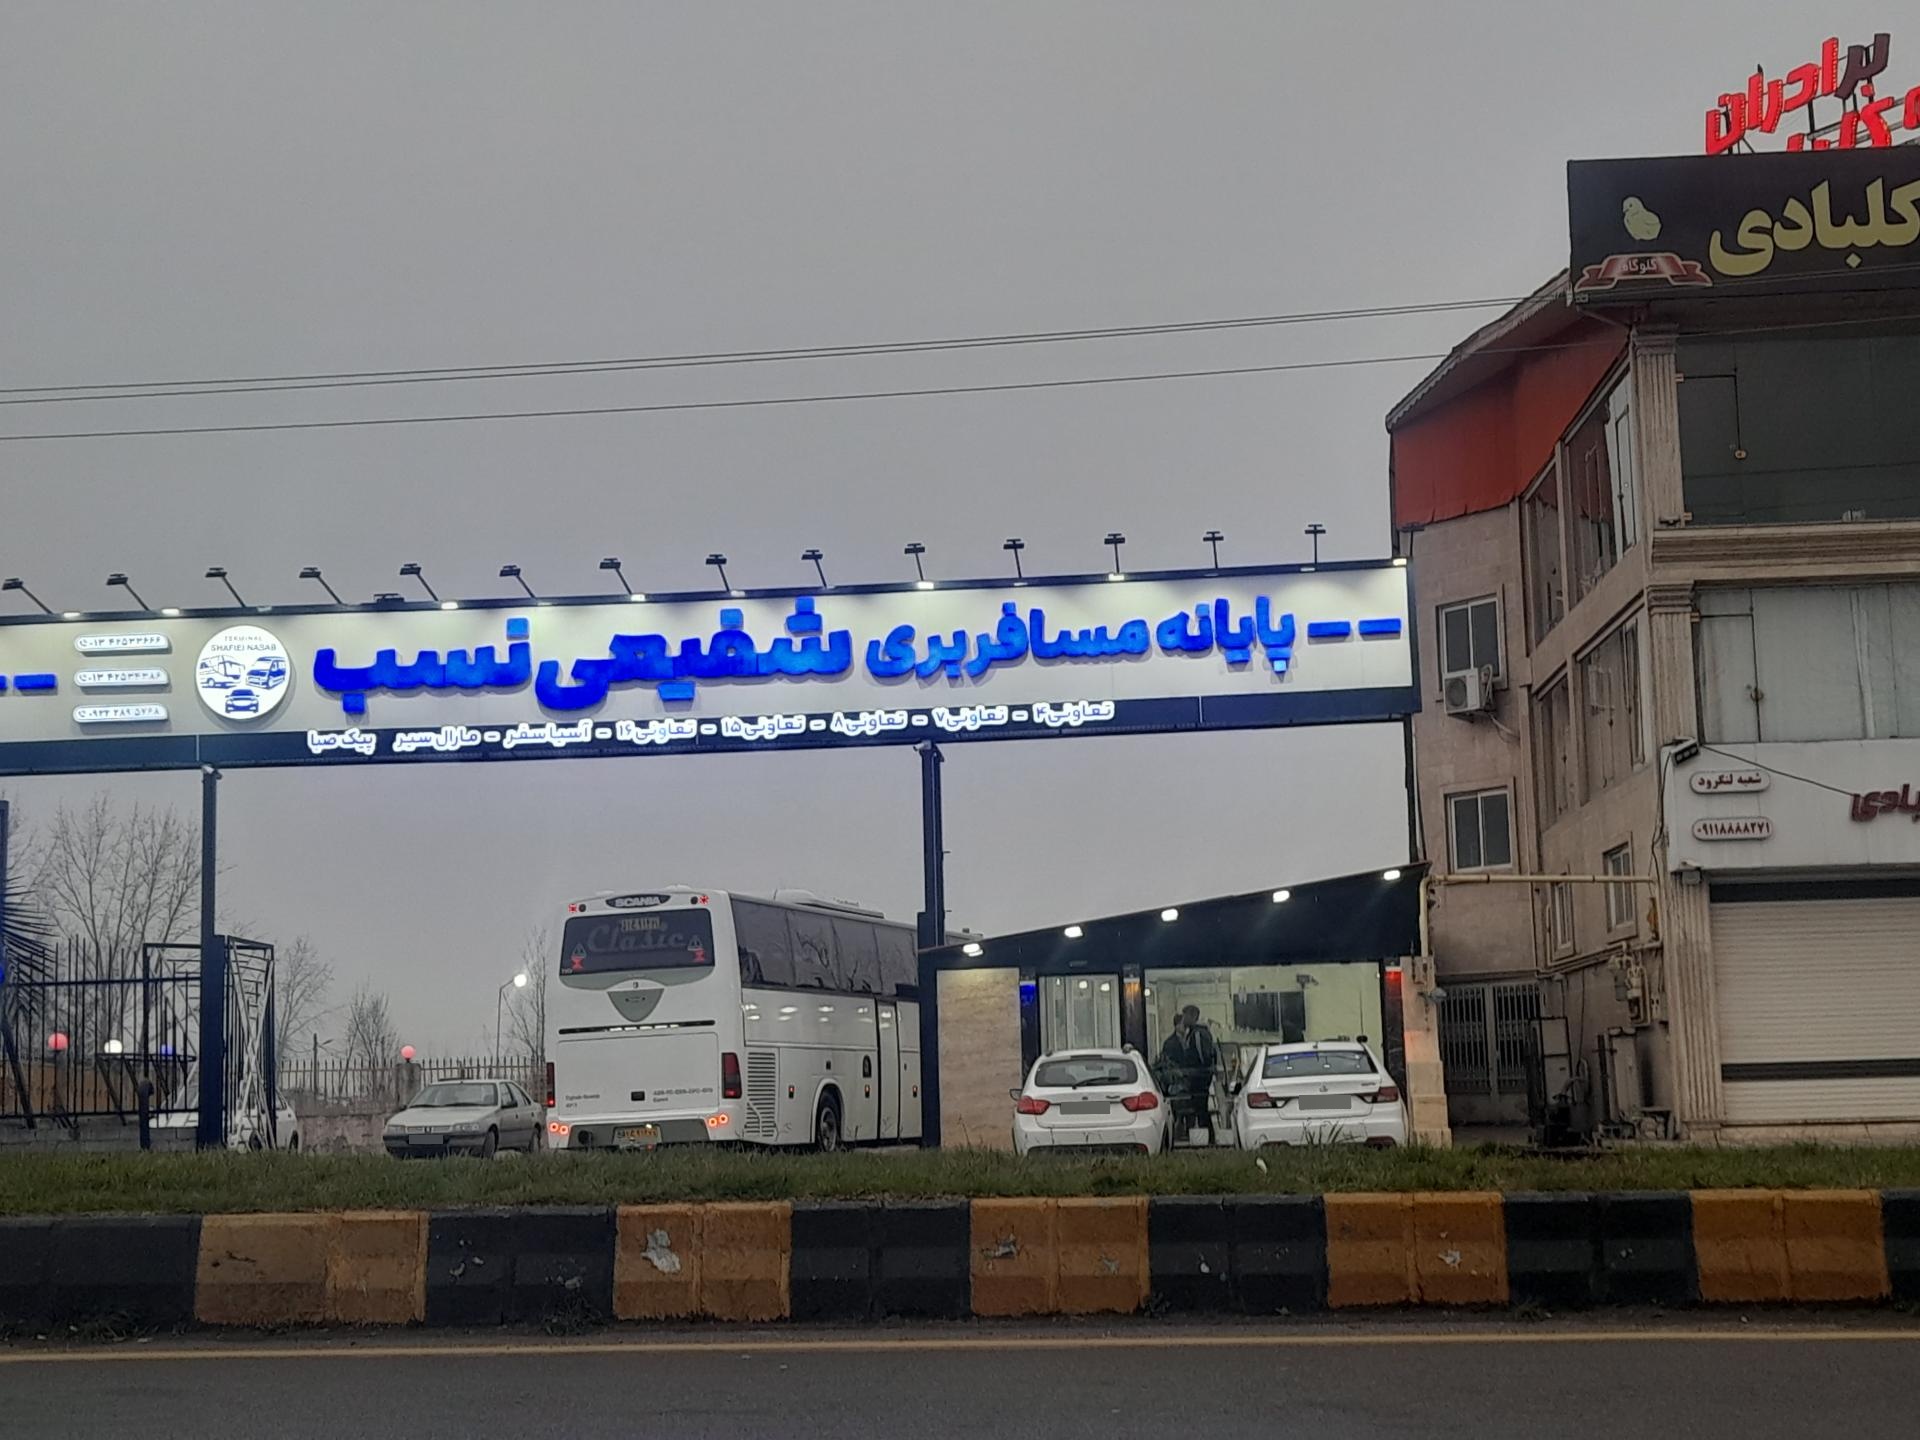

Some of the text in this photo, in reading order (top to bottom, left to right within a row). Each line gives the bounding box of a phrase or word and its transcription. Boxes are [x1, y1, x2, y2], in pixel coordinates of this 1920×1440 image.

[1708, 176, 1920, 277] کلبادی
[313, 595, 1296, 714] پایانه مسافربری شفیعی نسب
[1697, 772, 1762, 791] شعبه لنگرود
[615, 896, 661, 908] SCANIA
